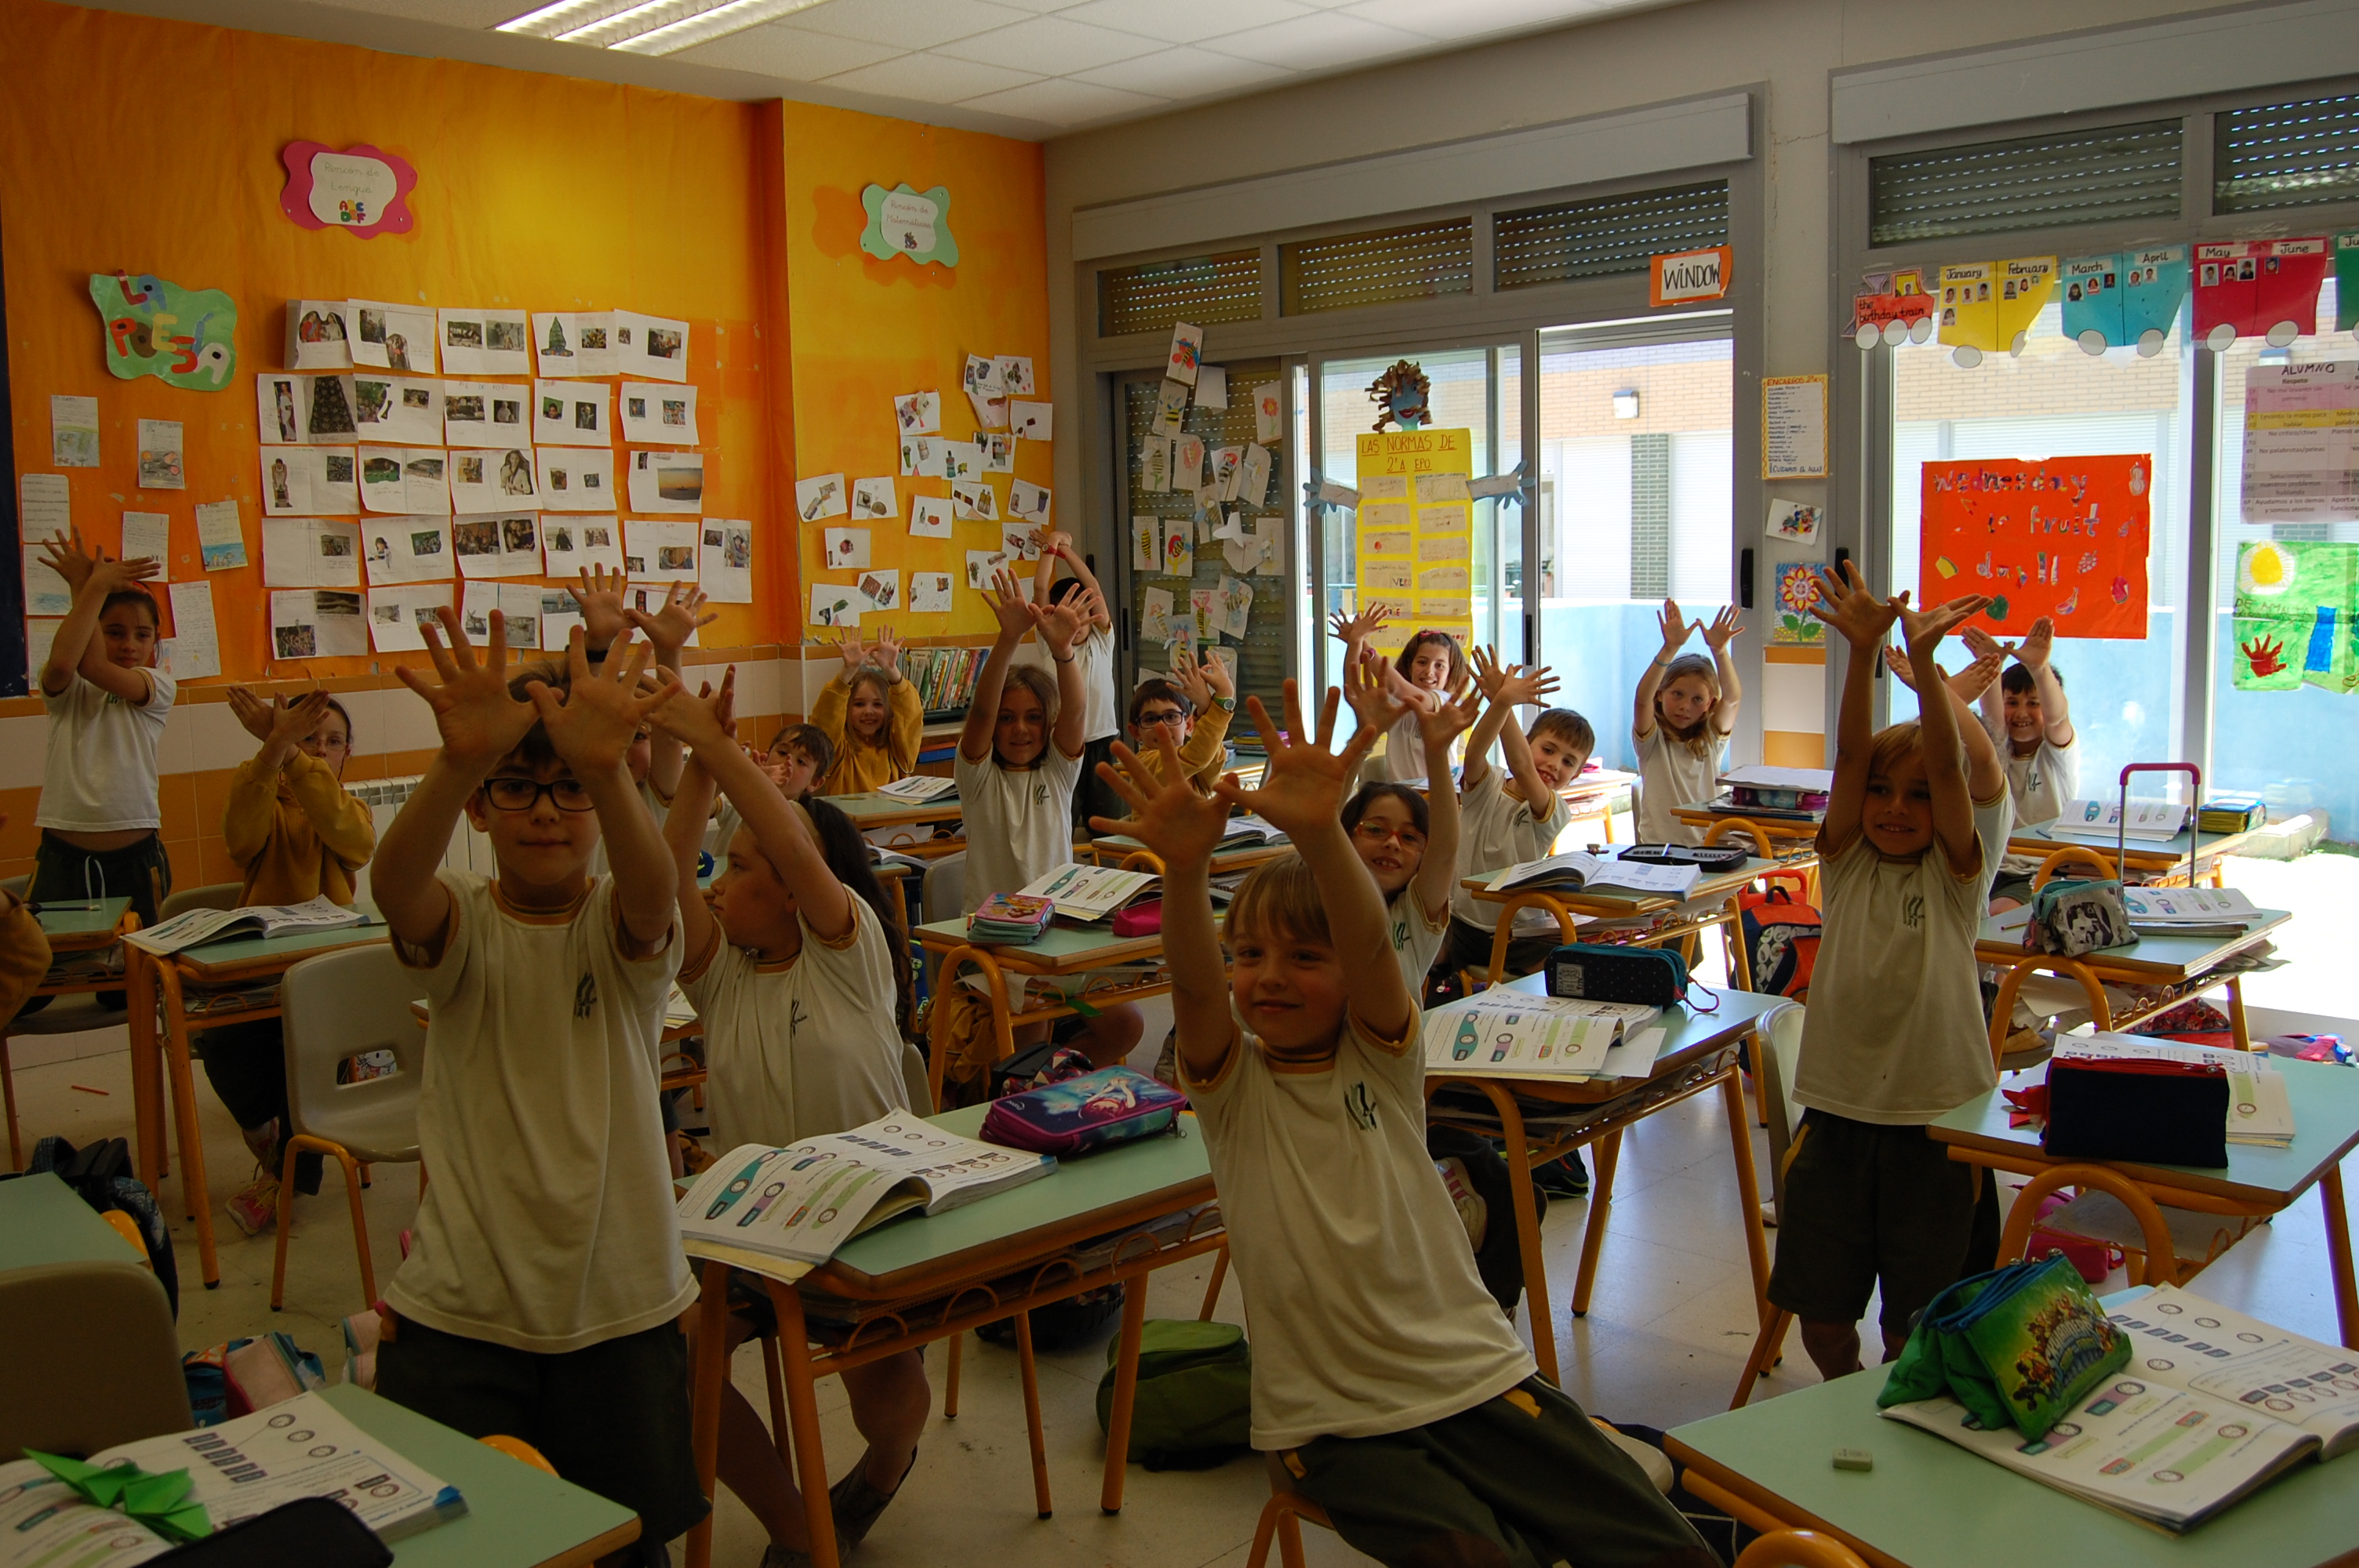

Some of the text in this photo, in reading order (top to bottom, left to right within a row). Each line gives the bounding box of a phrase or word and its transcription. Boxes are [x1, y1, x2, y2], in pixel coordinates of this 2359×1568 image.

[2205, 246, 2230, 259] May
[2280, 243, 2310, 254] June
[2142, 252, 2169, 265] April
[1946, 267, 1983, 281] January
[2008, 262, 2048, 276] February
[2071, 260, 2104, 275] March
[118, 269, 168, 313] LA
[1859, 299, 1874, 310] the
[1859, 307, 1925, 324] birthday train
[2281, 363, 2335, 376] ALUMNO
[1767, 376, 1805, 387] ENCARGOS
[1361, 434, 1456, 454] LAS NORMAS DE
[1414, 458, 1430, 470] EPO
[2030, 503, 2099, 537] fruit
